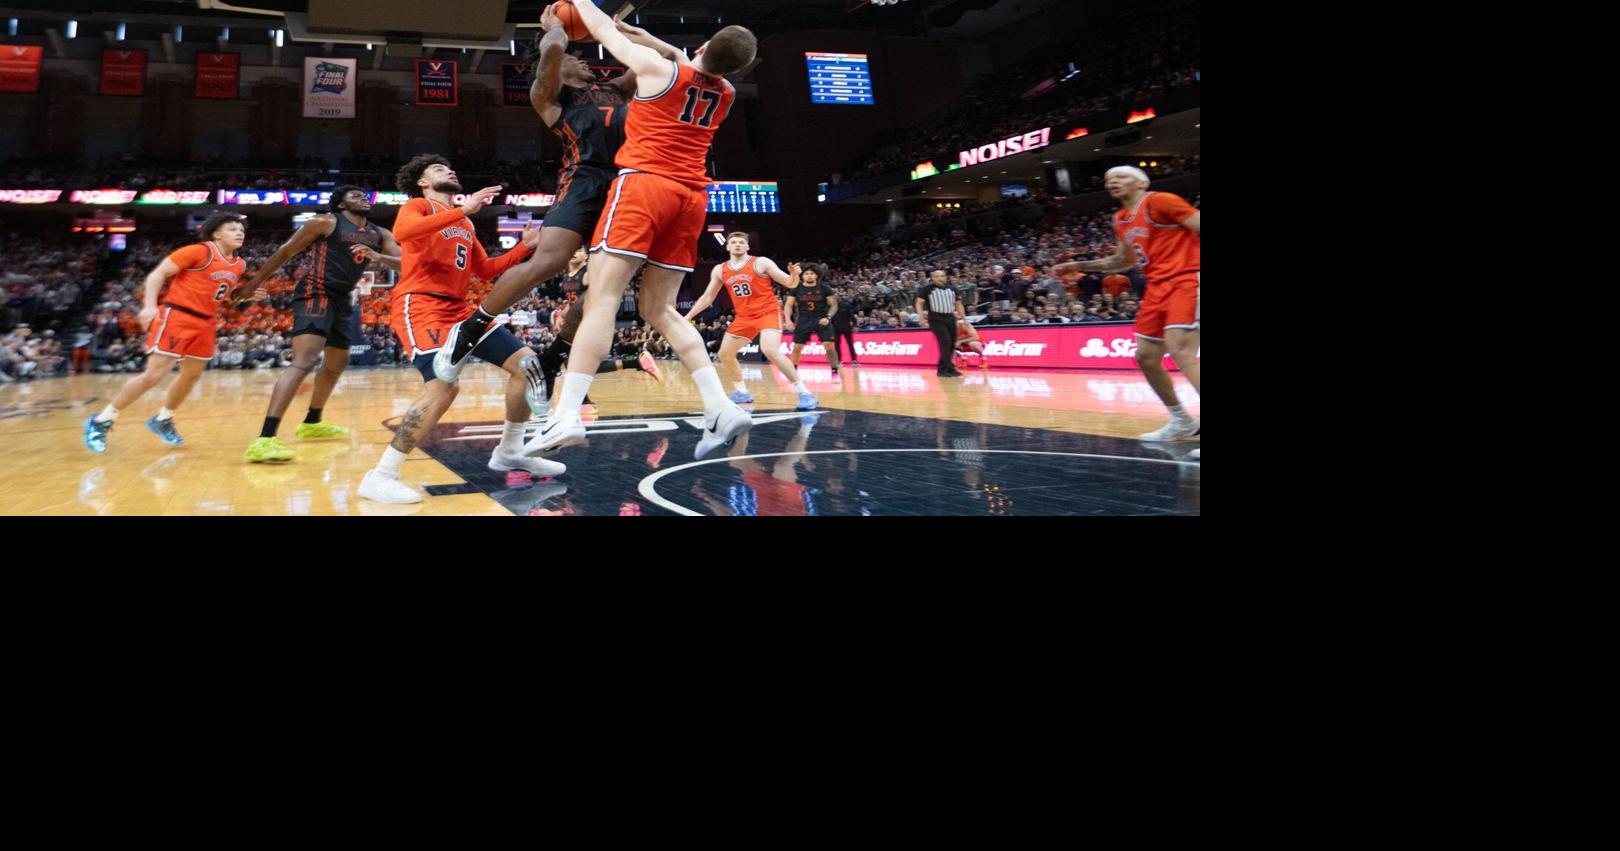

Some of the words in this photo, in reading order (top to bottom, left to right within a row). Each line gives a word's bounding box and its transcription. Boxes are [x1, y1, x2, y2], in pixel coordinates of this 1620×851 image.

[316, 77, 343, 86] FOUR
[319, 71, 344, 79] FINAL
[423, 89, 449, 99] 1981
[508, 92, 529, 101] 198
[318, 108, 341, 116] 2019
[679, 86, 721, 128] 17
[598, 106, 615, 127] 7
[959, 127, 1051, 168] NOISE!
[454, 243, 467, 270] 5
[213, 282, 229, 302] 2
[732, 282, 752, 298] 28
[806, 301, 816, 311] 3
